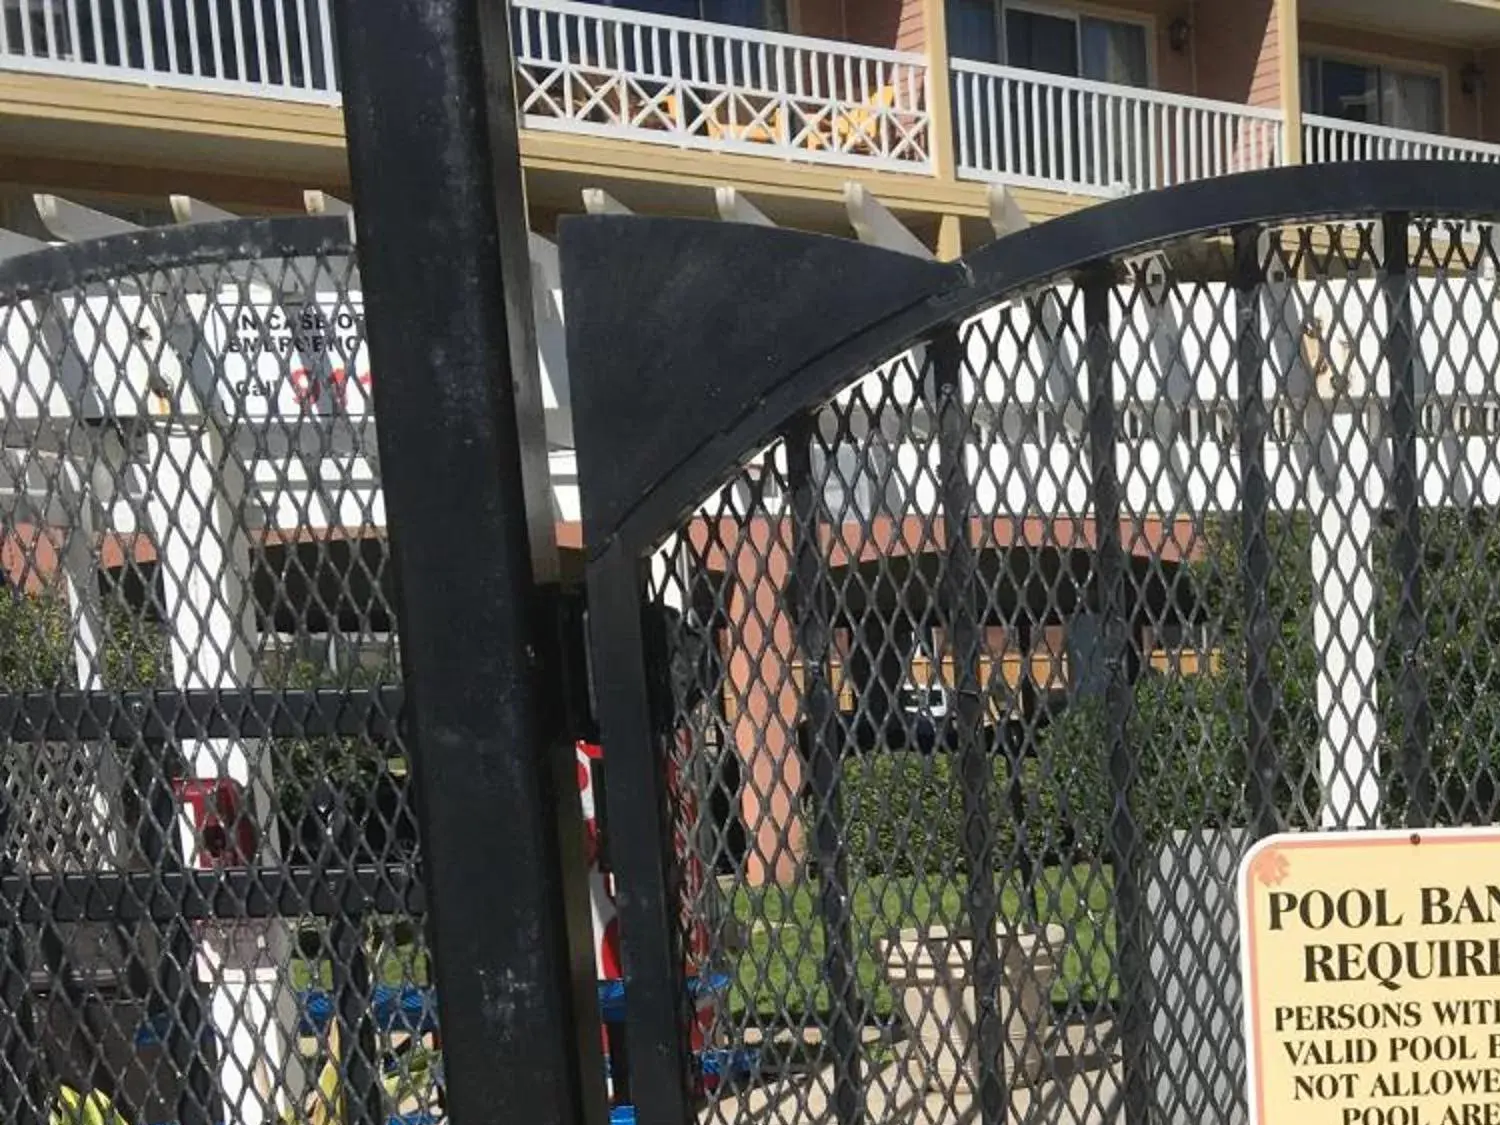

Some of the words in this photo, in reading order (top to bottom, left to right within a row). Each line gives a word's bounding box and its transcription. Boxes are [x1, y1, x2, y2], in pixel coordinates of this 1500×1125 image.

[228, 335, 366, 353] EMERGENC
[1269, 888, 1403, 931] POOL
[1275, 1001, 1422, 1032] PERSONS
[1283, 1038, 1378, 1066] VALID
[1389, 1035, 1477, 1063] POOL
[1294, 1073, 1359, 1101] NOT
